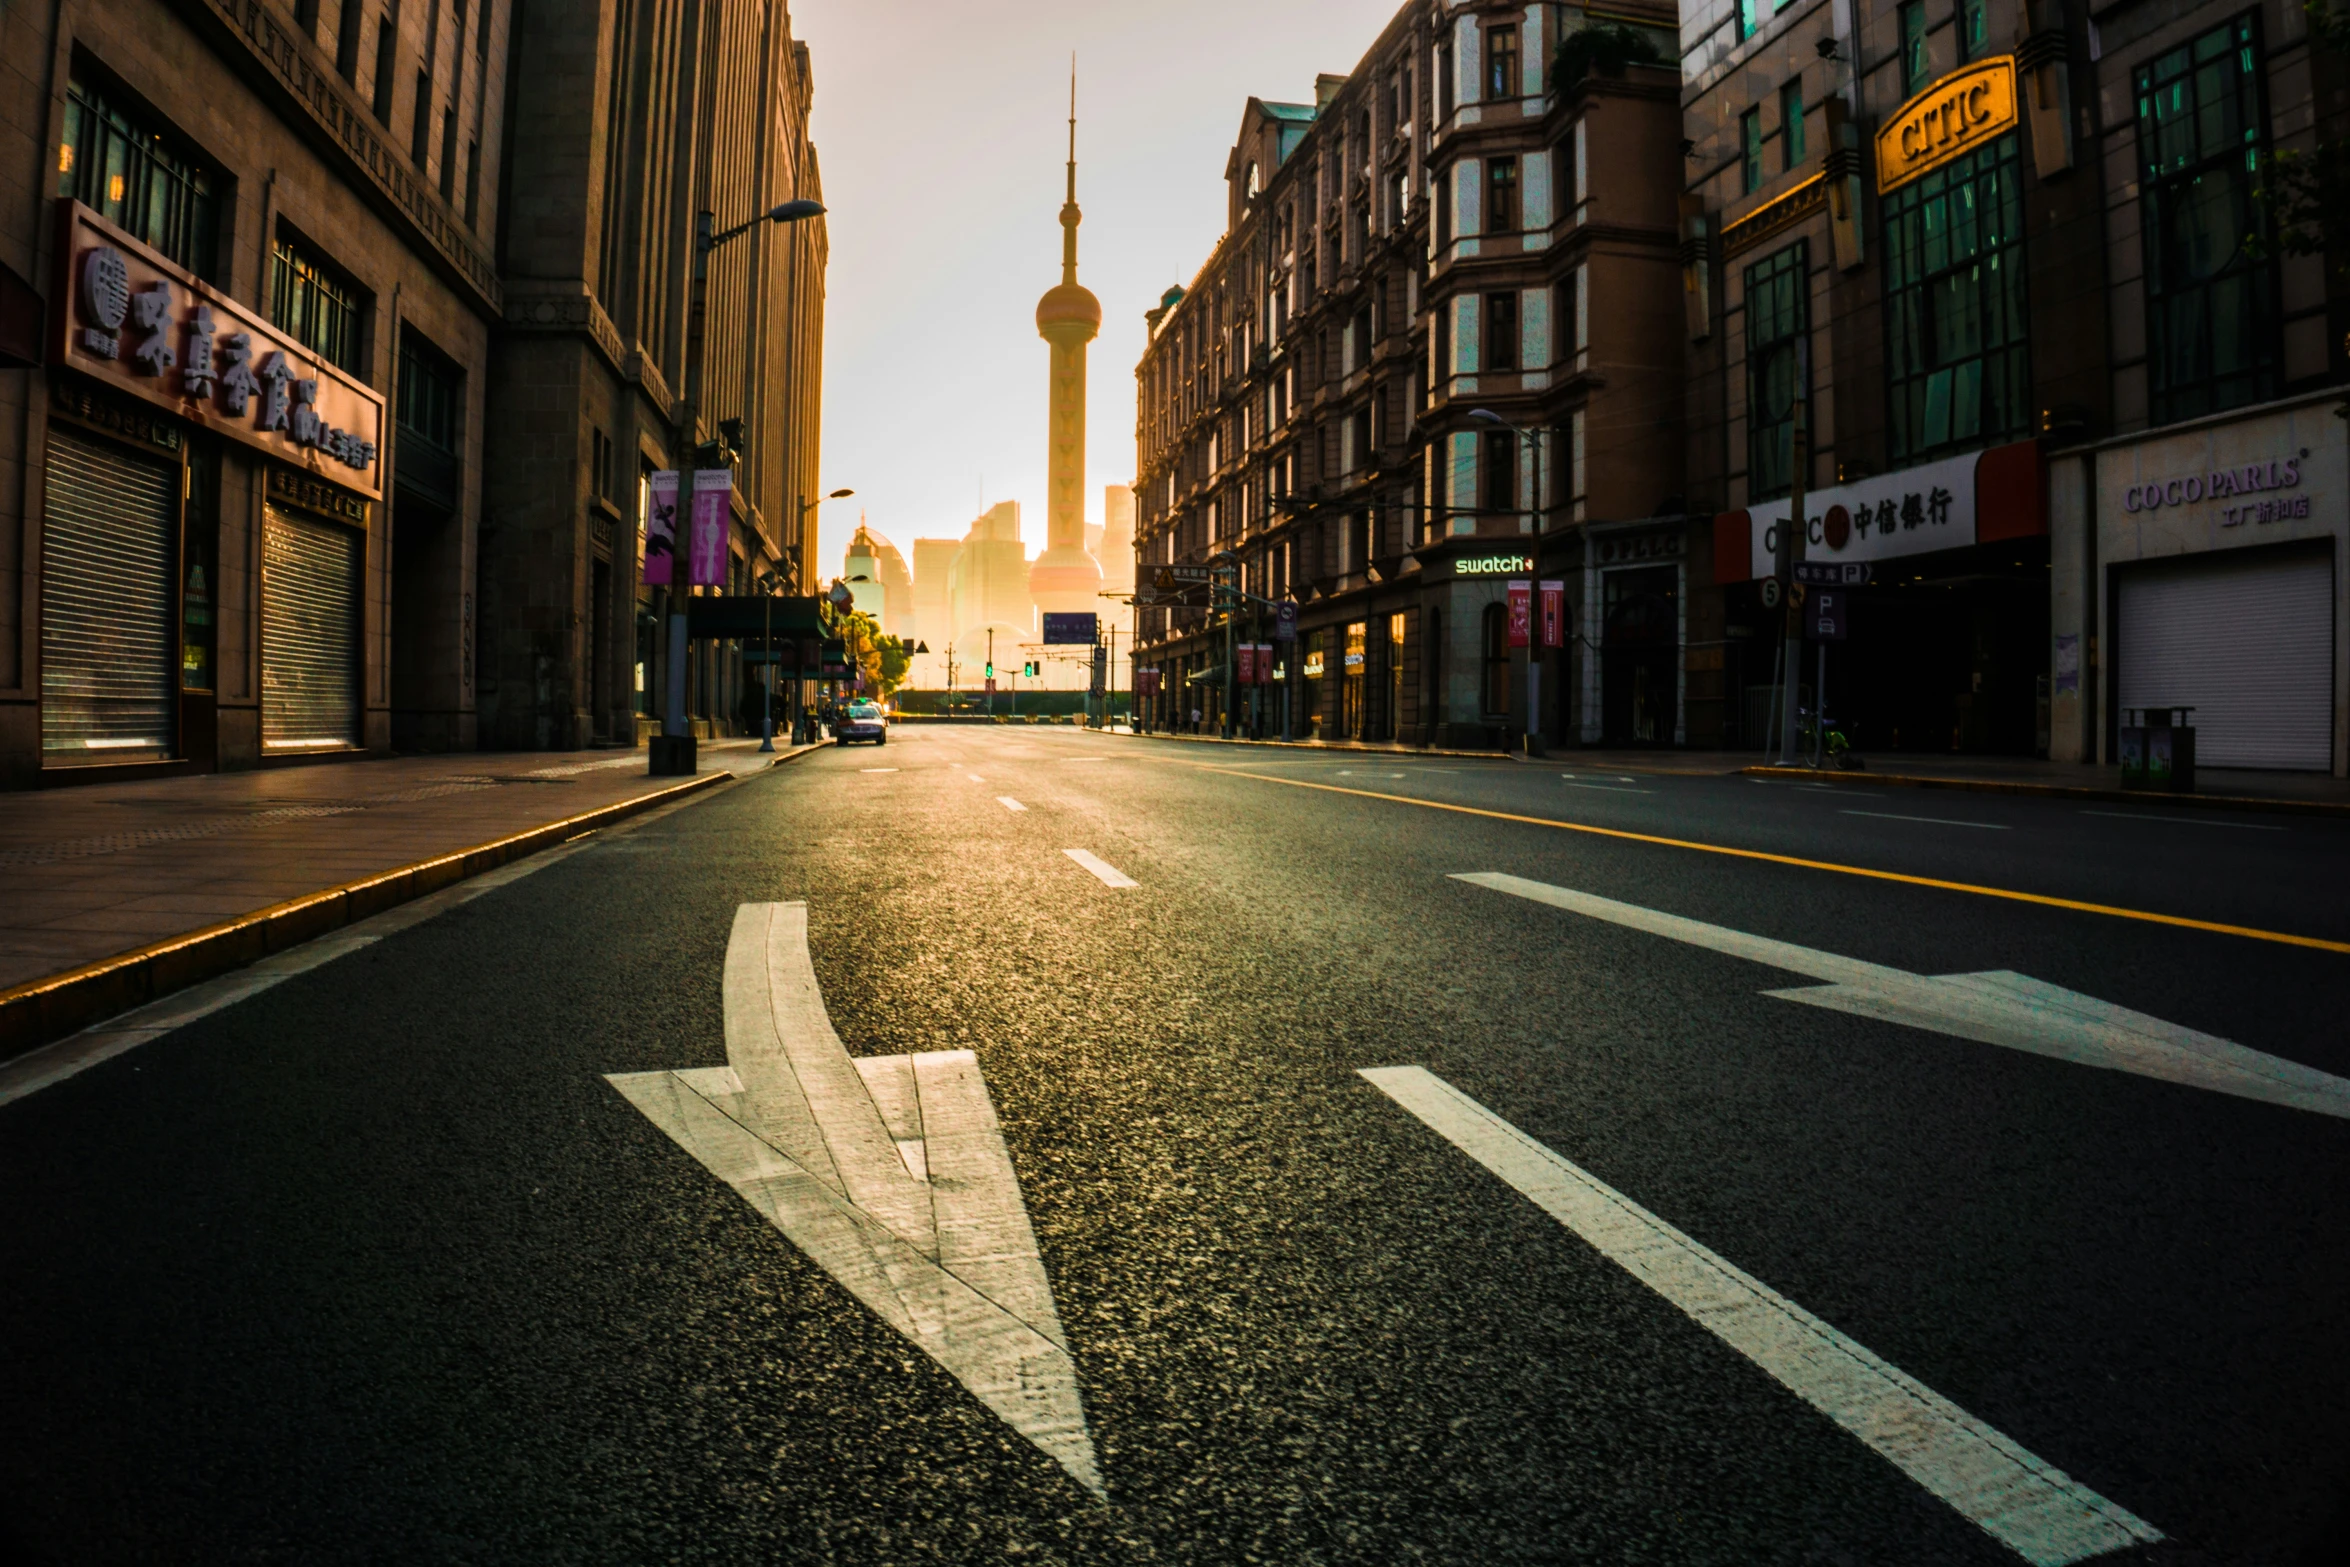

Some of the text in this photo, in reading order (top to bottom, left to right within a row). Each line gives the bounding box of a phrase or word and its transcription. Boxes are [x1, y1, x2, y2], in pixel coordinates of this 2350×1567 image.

[1900, 80, 1990, 162] CITIC
[2123, 476, 2204, 513] COCO
[2221, 493, 2310, 528] 工厂折扣店
[1853, 486, 1953, 540] 中信银行
[1455, 556, 1524, 574] swatch
[1766, 584, 1775, 603] 5
[1819, 595, 1833, 615] P
